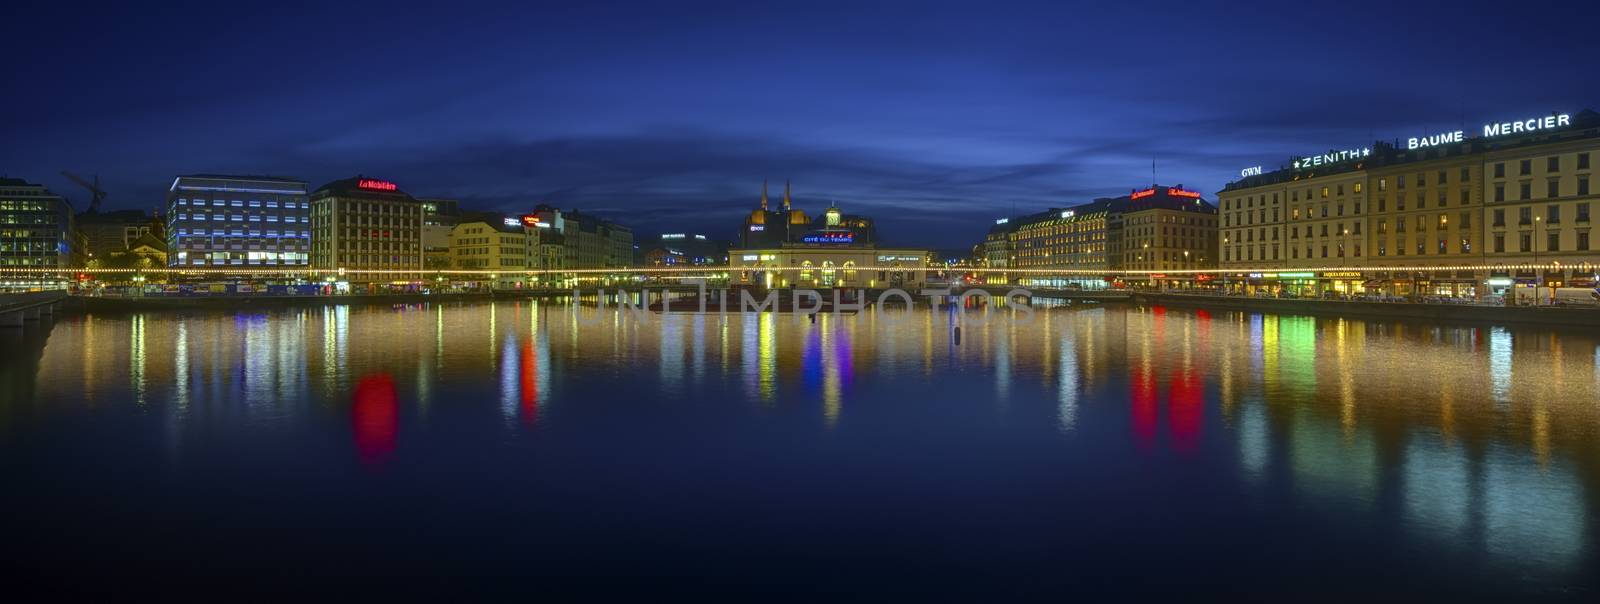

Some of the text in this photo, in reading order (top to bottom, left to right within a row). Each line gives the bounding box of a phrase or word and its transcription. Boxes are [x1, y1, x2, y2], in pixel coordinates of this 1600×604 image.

[1408, 114, 1571, 150] BAUME MERCIER
[1302, 149, 1360, 168] ZENITH
[1241, 166, 1262, 177] GWM
[359, 180, 368, 188] La
